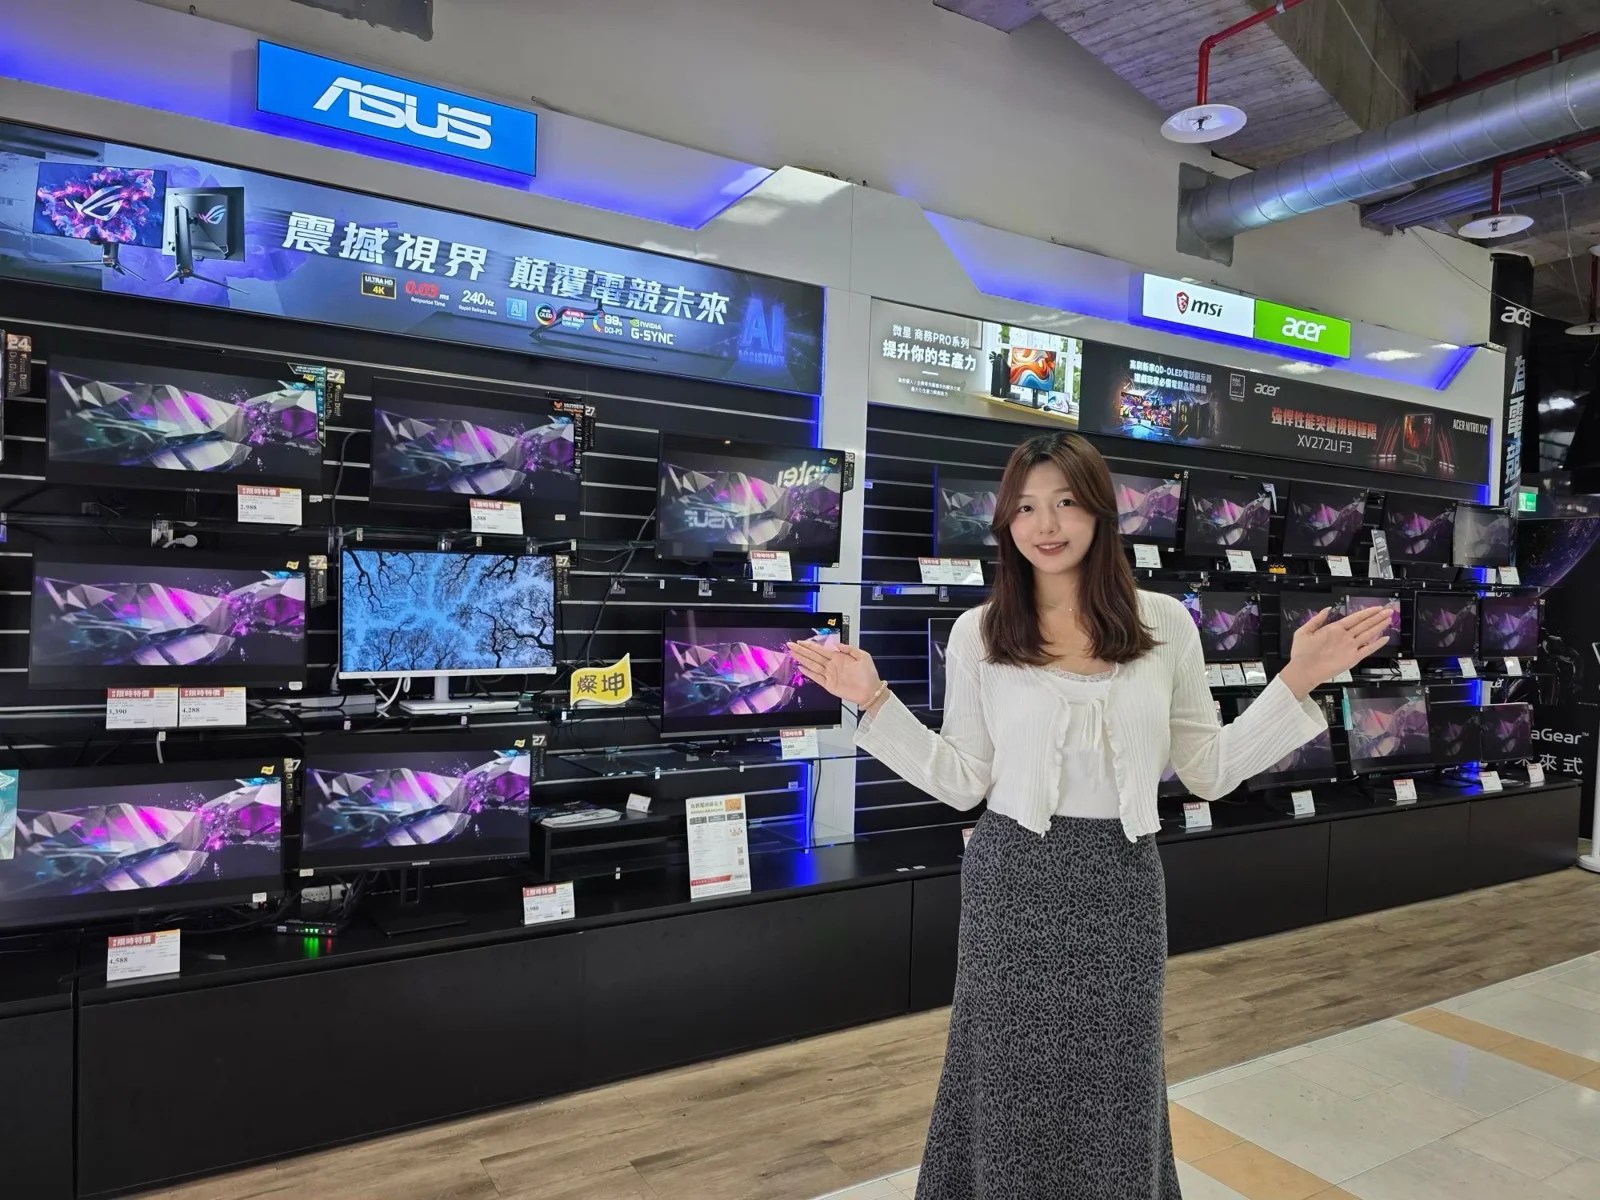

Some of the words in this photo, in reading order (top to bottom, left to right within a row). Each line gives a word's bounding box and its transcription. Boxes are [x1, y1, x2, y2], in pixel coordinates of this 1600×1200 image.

[313, 76, 492, 150] ASUS
[282, 211, 488, 281] 震撼視界
[508, 255, 730, 325] 顛覆電競未來
[365, 276, 383, 285] ULTRA
[383, 278, 394, 286] HD
[372, 286, 385, 295] 4K
[405, 280, 439, 298] 0.03
[434, 300, 446, 308] Time
[511, 302, 522, 314] AI
[1190, 298, 1224, 318] msi
[539, 311, 553, 320] OLED
[604, 326, 623, 336] DCI-P3
[1281, 316, 1327, 343] acer
[630, 330, 674, 345] G-SYNC
[882, 339, 977, 372] 提升你的生產力
[1254, 382, 1281, 397] acer
[585, 405, 596, 416] 27
[1452, 418, 1465, 431] ACER
[1296, 434, 1338, 453] XV272U
[1339, 441, 1353, 454] F3
[556, 555, 569, 566] 27
[576, 672, 625, 697] 燦坤
[533, 734, 546, 746] 27
